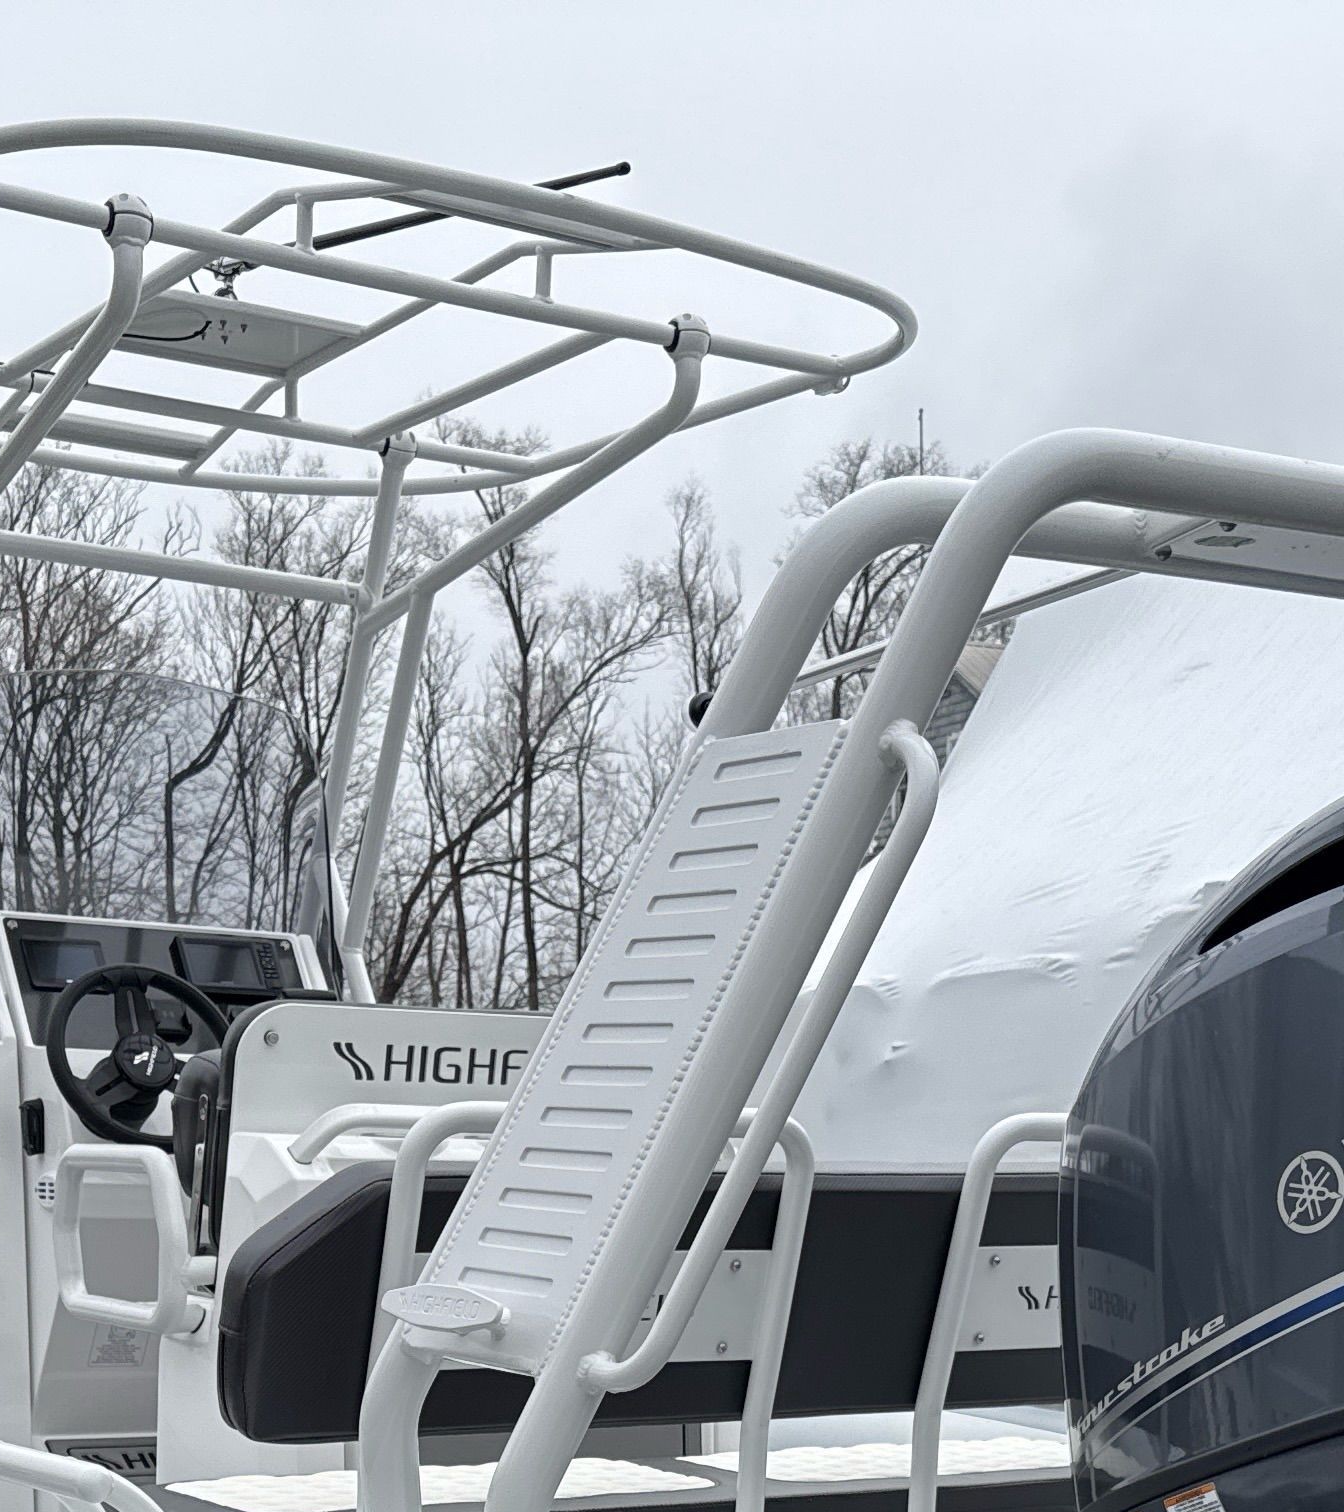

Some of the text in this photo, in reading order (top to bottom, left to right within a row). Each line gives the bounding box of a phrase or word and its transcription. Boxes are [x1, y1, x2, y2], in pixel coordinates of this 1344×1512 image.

[383, 1044, 529, 1085] HIGHF
[410, 1293, 482, 1321] HIGHFIELD
[1116, 1314, 1227, 1396] stroke
